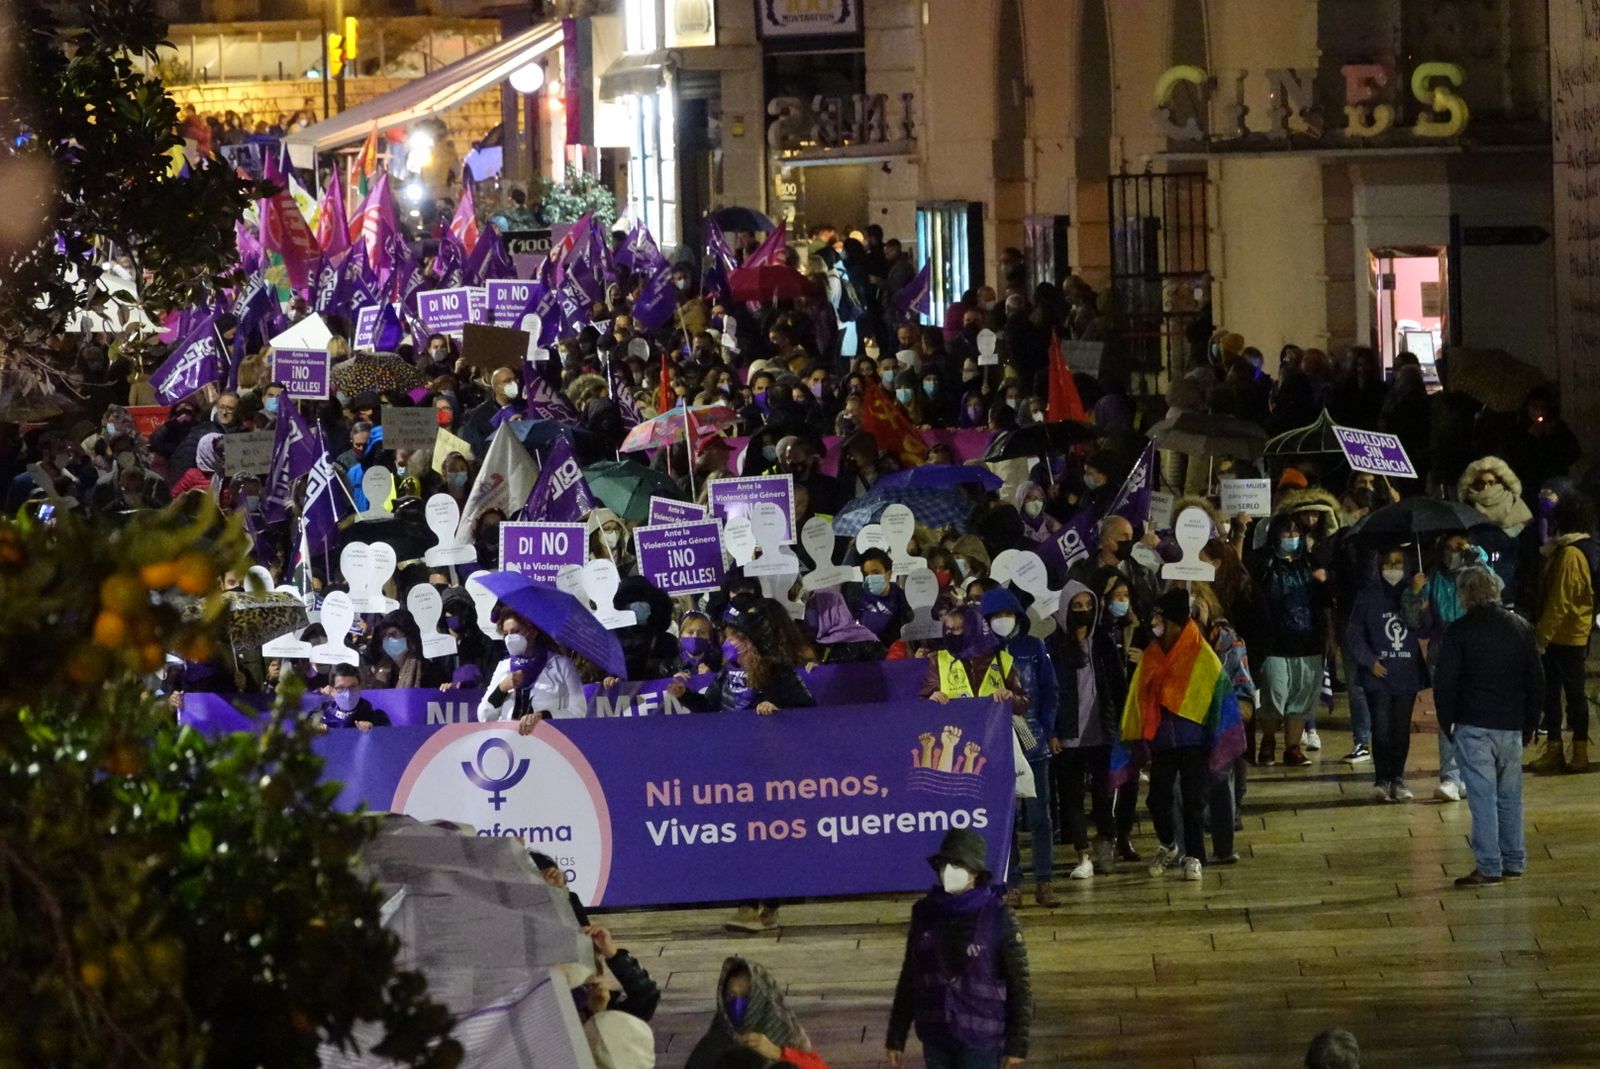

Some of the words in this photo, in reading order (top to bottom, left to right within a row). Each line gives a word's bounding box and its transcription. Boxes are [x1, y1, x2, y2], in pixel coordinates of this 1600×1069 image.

[1153, 62, 1469, 141] CINES
[498, 289, 507, 301] DI
[511, 286, 529, 301] NO
[429, 300, 438, 312] DI
[442, 294, 459, 310] NO
[291, 366, 310, 380] ¡NO
[291, 381, 321, 393] CALLES!
[1340, 429, 1398, 449] IGUALDAD
[1364, 445, 1384, 459] SIN
[1350, 453, 1411, 473] VIOLENCIA
[737, 482, 754, 491] Ante
[715, 493, 748, 502] Violencia
[749, 491, 758, 499] de
[759, 490, 785, 499] Género
[667, 505, 680, 514] Ante
[653, 512, 675, 523] Violencia
[664, 529, 682, 538] Ante
[682, 528, 690, 536] la
[519, 537, 533, 555] DI
[541, 531, 569, 556] NO
[643, 537, 677, 550] Violencia
[678, 537, 687, 546] de
[688, 534, 716, 545] Género
[667, 547, 695, 569] ¡NO
[523, 561, 531, 570] la
[532, 562, 568, 571] Violen
[533, 574, 546, 582] las
[654, 573, 669, 588] TE
[670, 567, 717, 587] CALLES!
[645, 778, 682, 808] Ni
[692, 780, 755, 804] una
[765, 773, 889, 803] menos,
[645, 818, 737, 847] Vivas
[747, 817, 808, 841] nos
[817, 807, 989, 843] queremos
